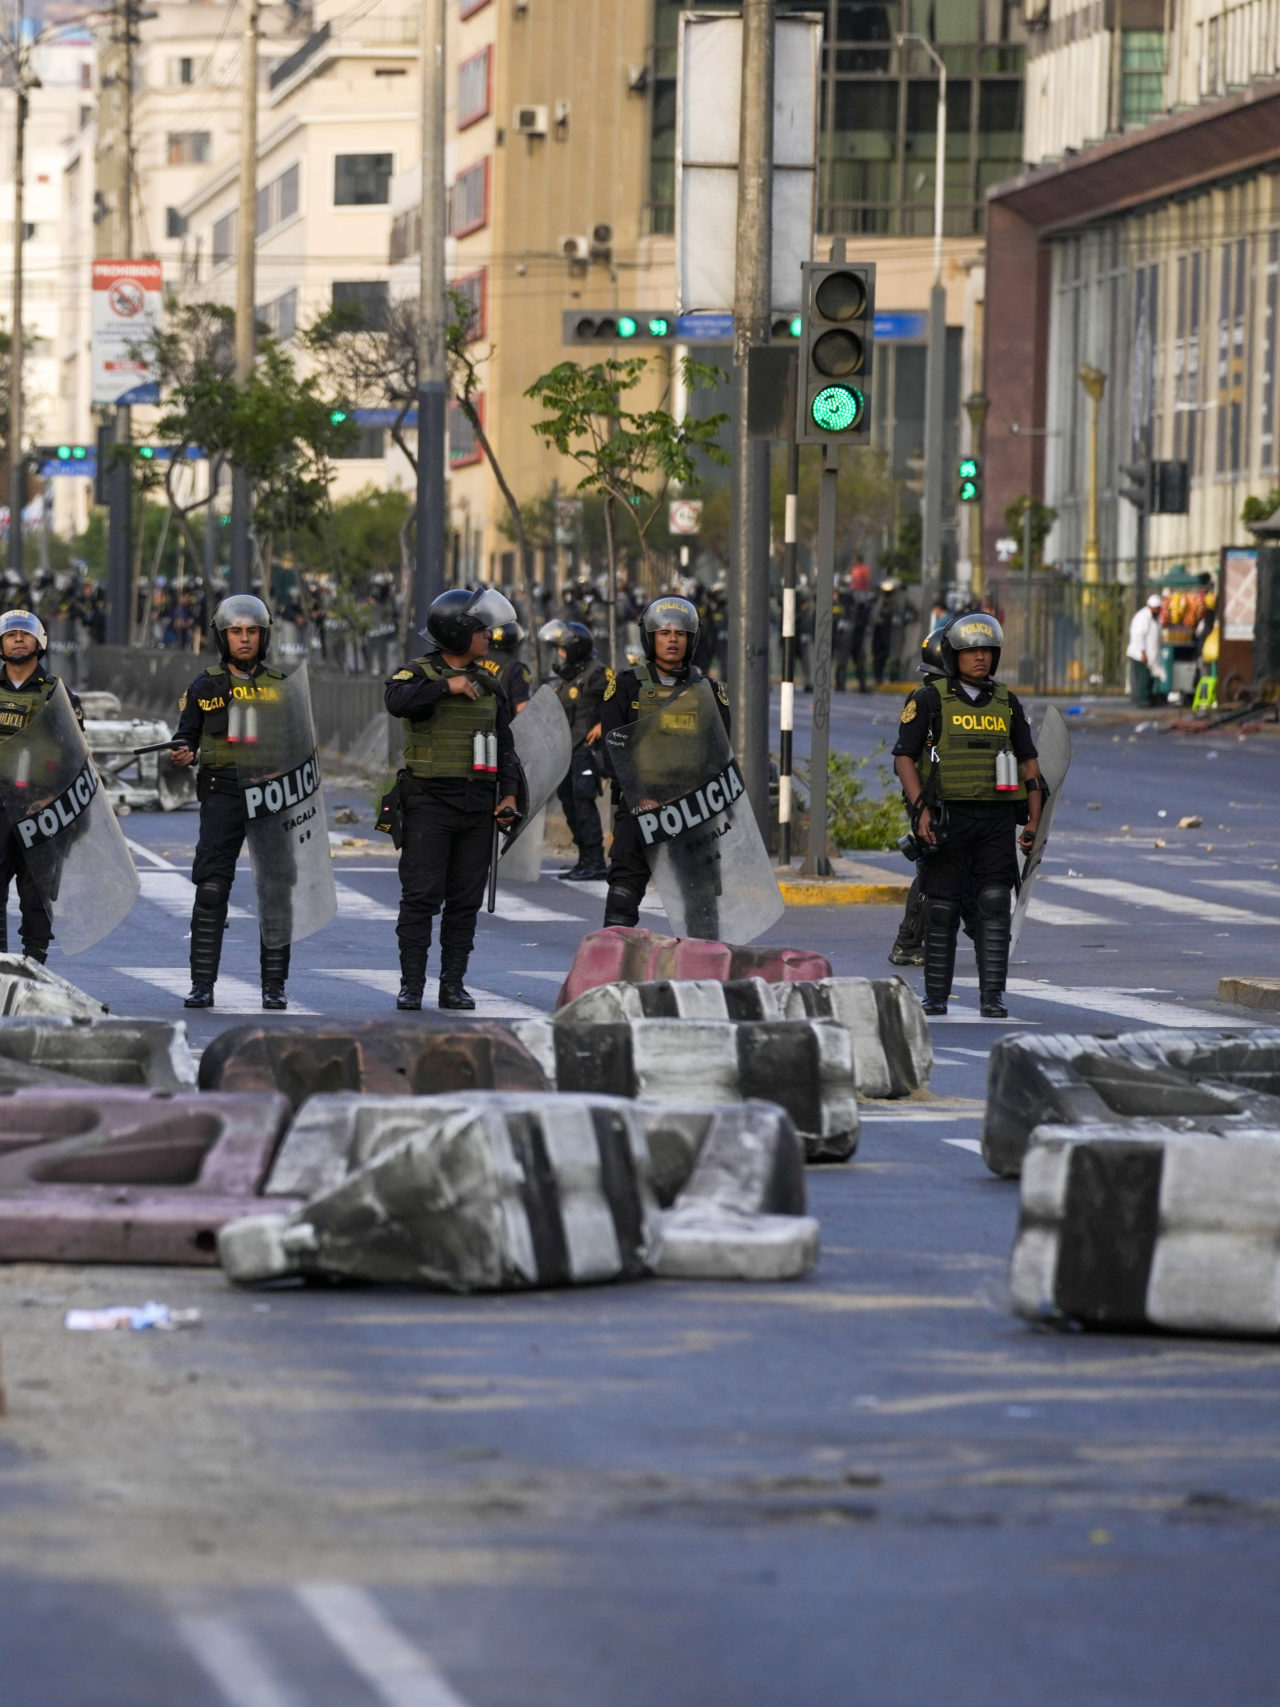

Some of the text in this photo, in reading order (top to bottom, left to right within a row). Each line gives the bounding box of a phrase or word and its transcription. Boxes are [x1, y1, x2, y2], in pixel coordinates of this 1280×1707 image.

[94, 263, 161, 278] PROHIBIDO
[960, 623, 994, 638] POLICIA
[951, 714, 1007, 731] POLICIA
[637, 765, 744, 845] POLICIA
[282, 806, 317, 832] TACALA
